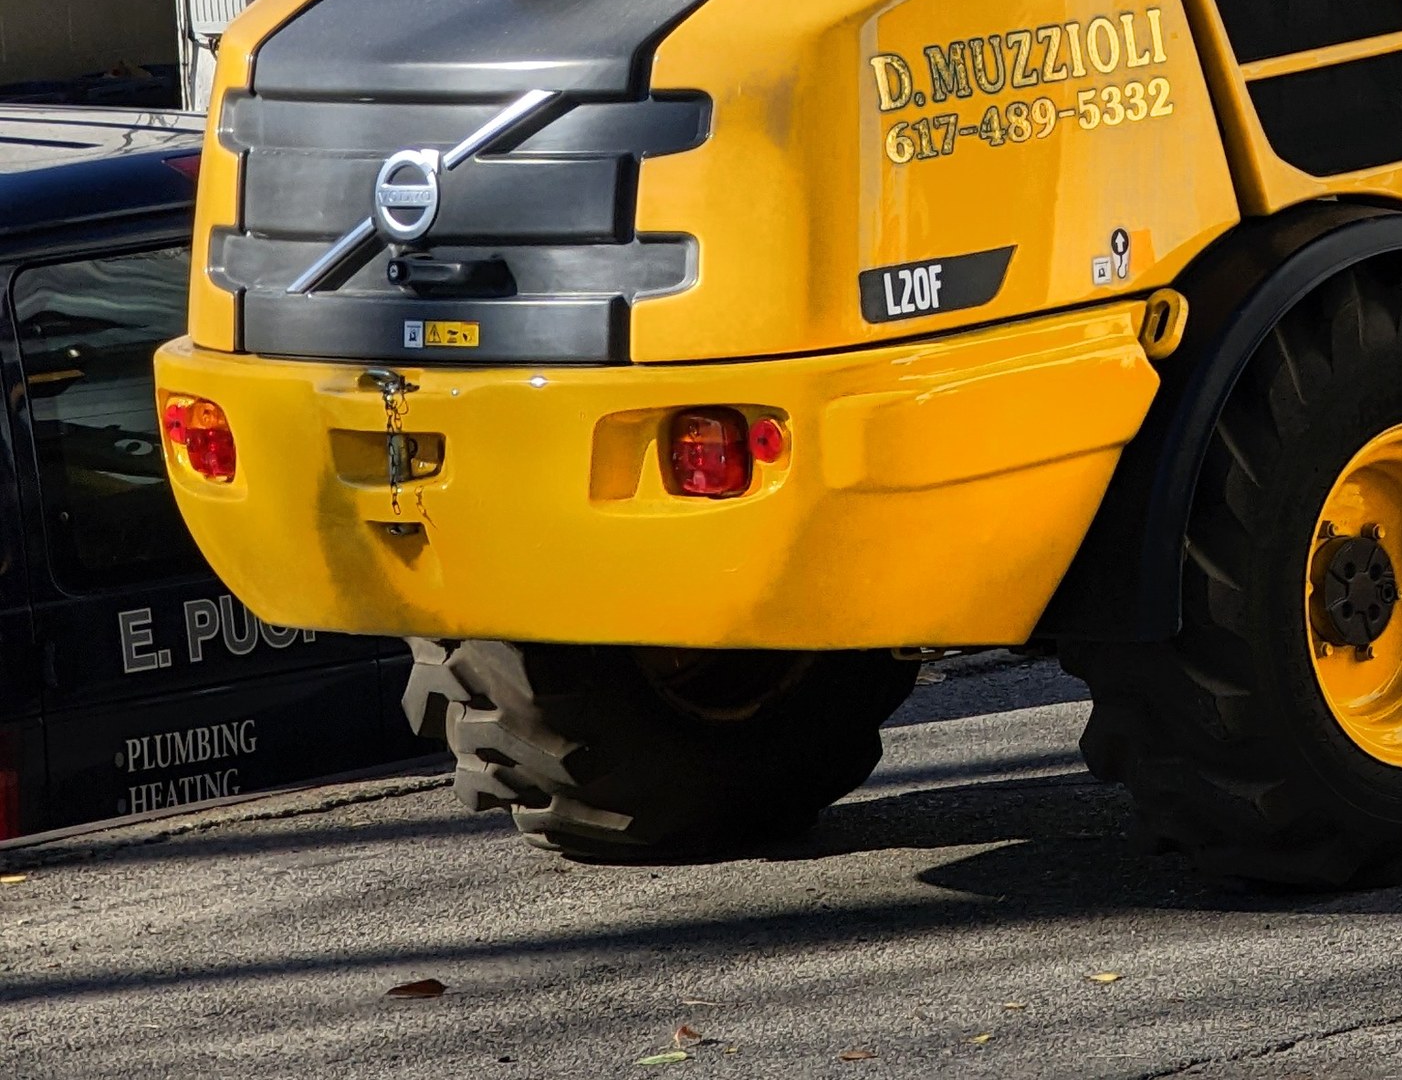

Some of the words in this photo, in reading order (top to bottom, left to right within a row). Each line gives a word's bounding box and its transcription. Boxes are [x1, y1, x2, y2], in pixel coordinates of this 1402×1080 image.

[884, 77, 1175, 164] 617-489-5332
[378, 189, 431, 202] VOLVO
[883, 264, 942, 316] L20F
[118, 607, 172, 673] E.
[183, 594, 316, 663] PU
[126, 719, 257, 772] PLUMBING
[129, 768, 241, 815] HEATING
